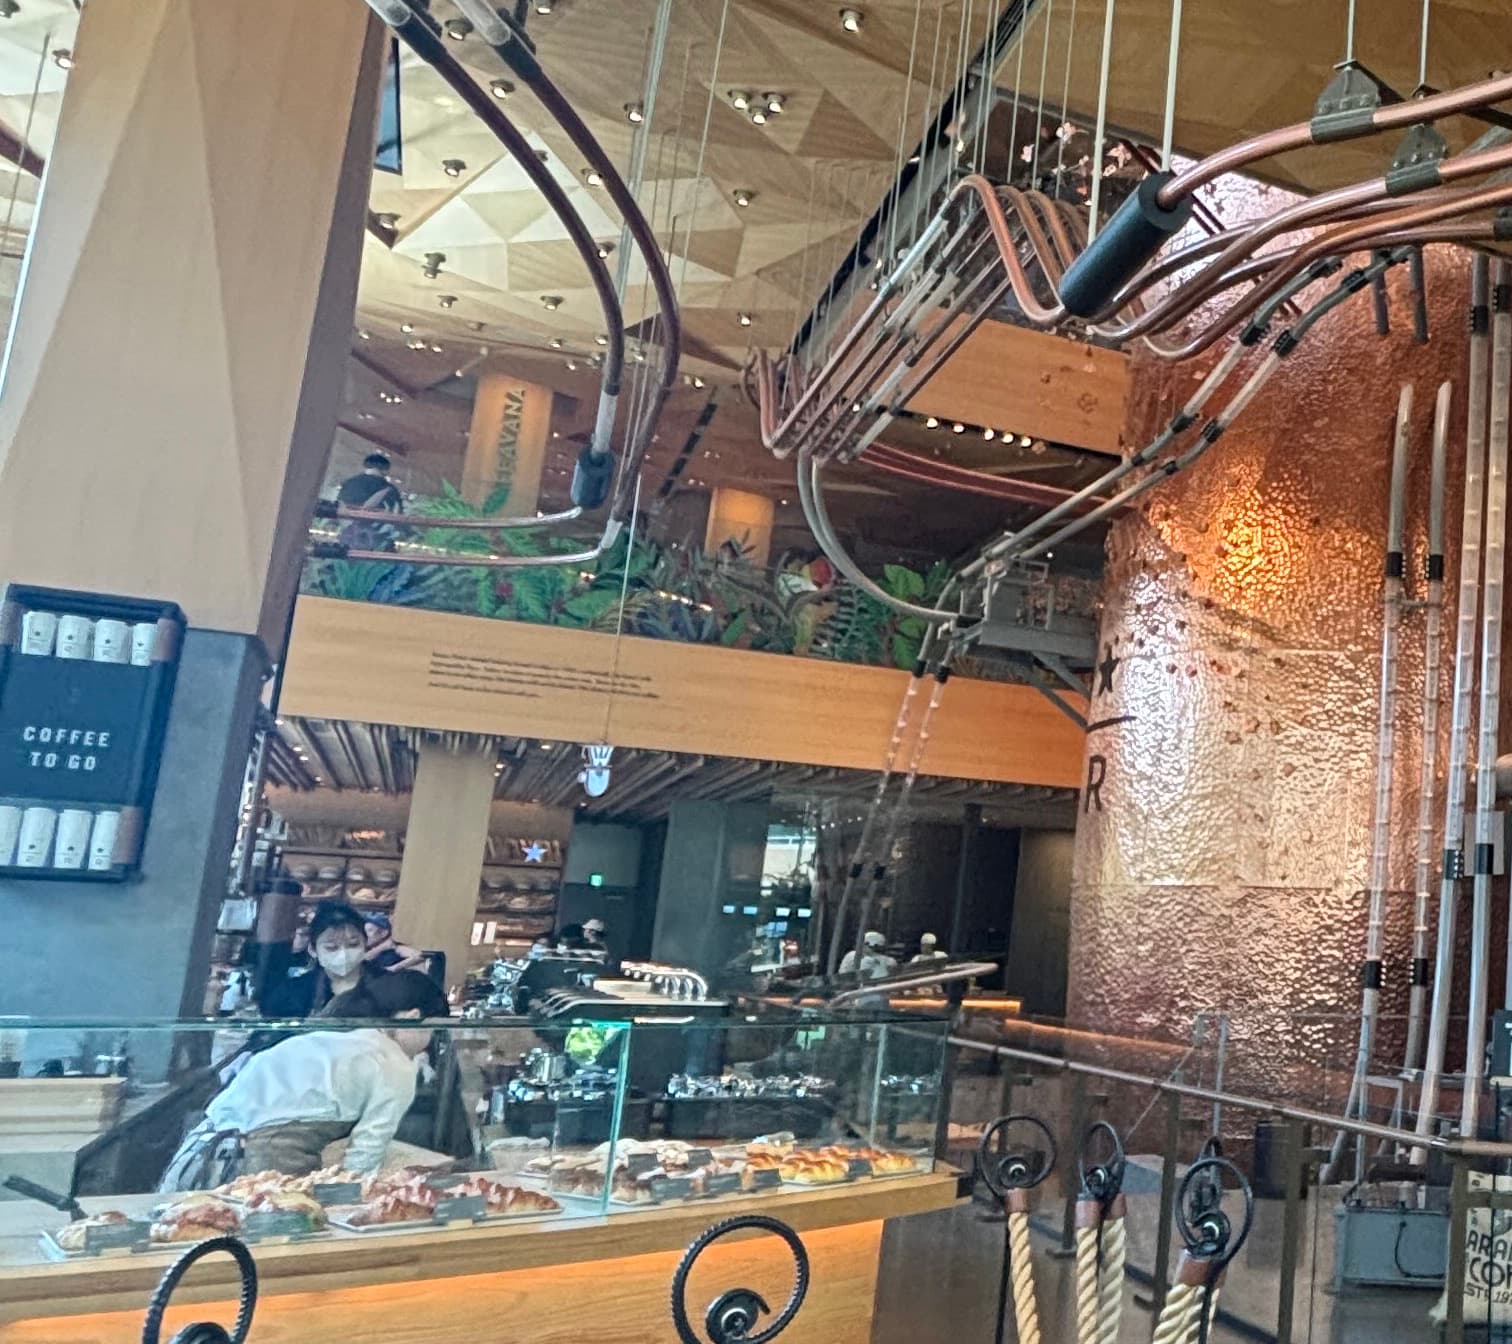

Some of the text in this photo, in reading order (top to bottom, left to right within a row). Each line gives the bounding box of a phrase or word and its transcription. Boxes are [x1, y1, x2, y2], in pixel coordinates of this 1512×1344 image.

[23, 726, 111, 748] COFFEE
[30, 752, 97, 770] TO GO
